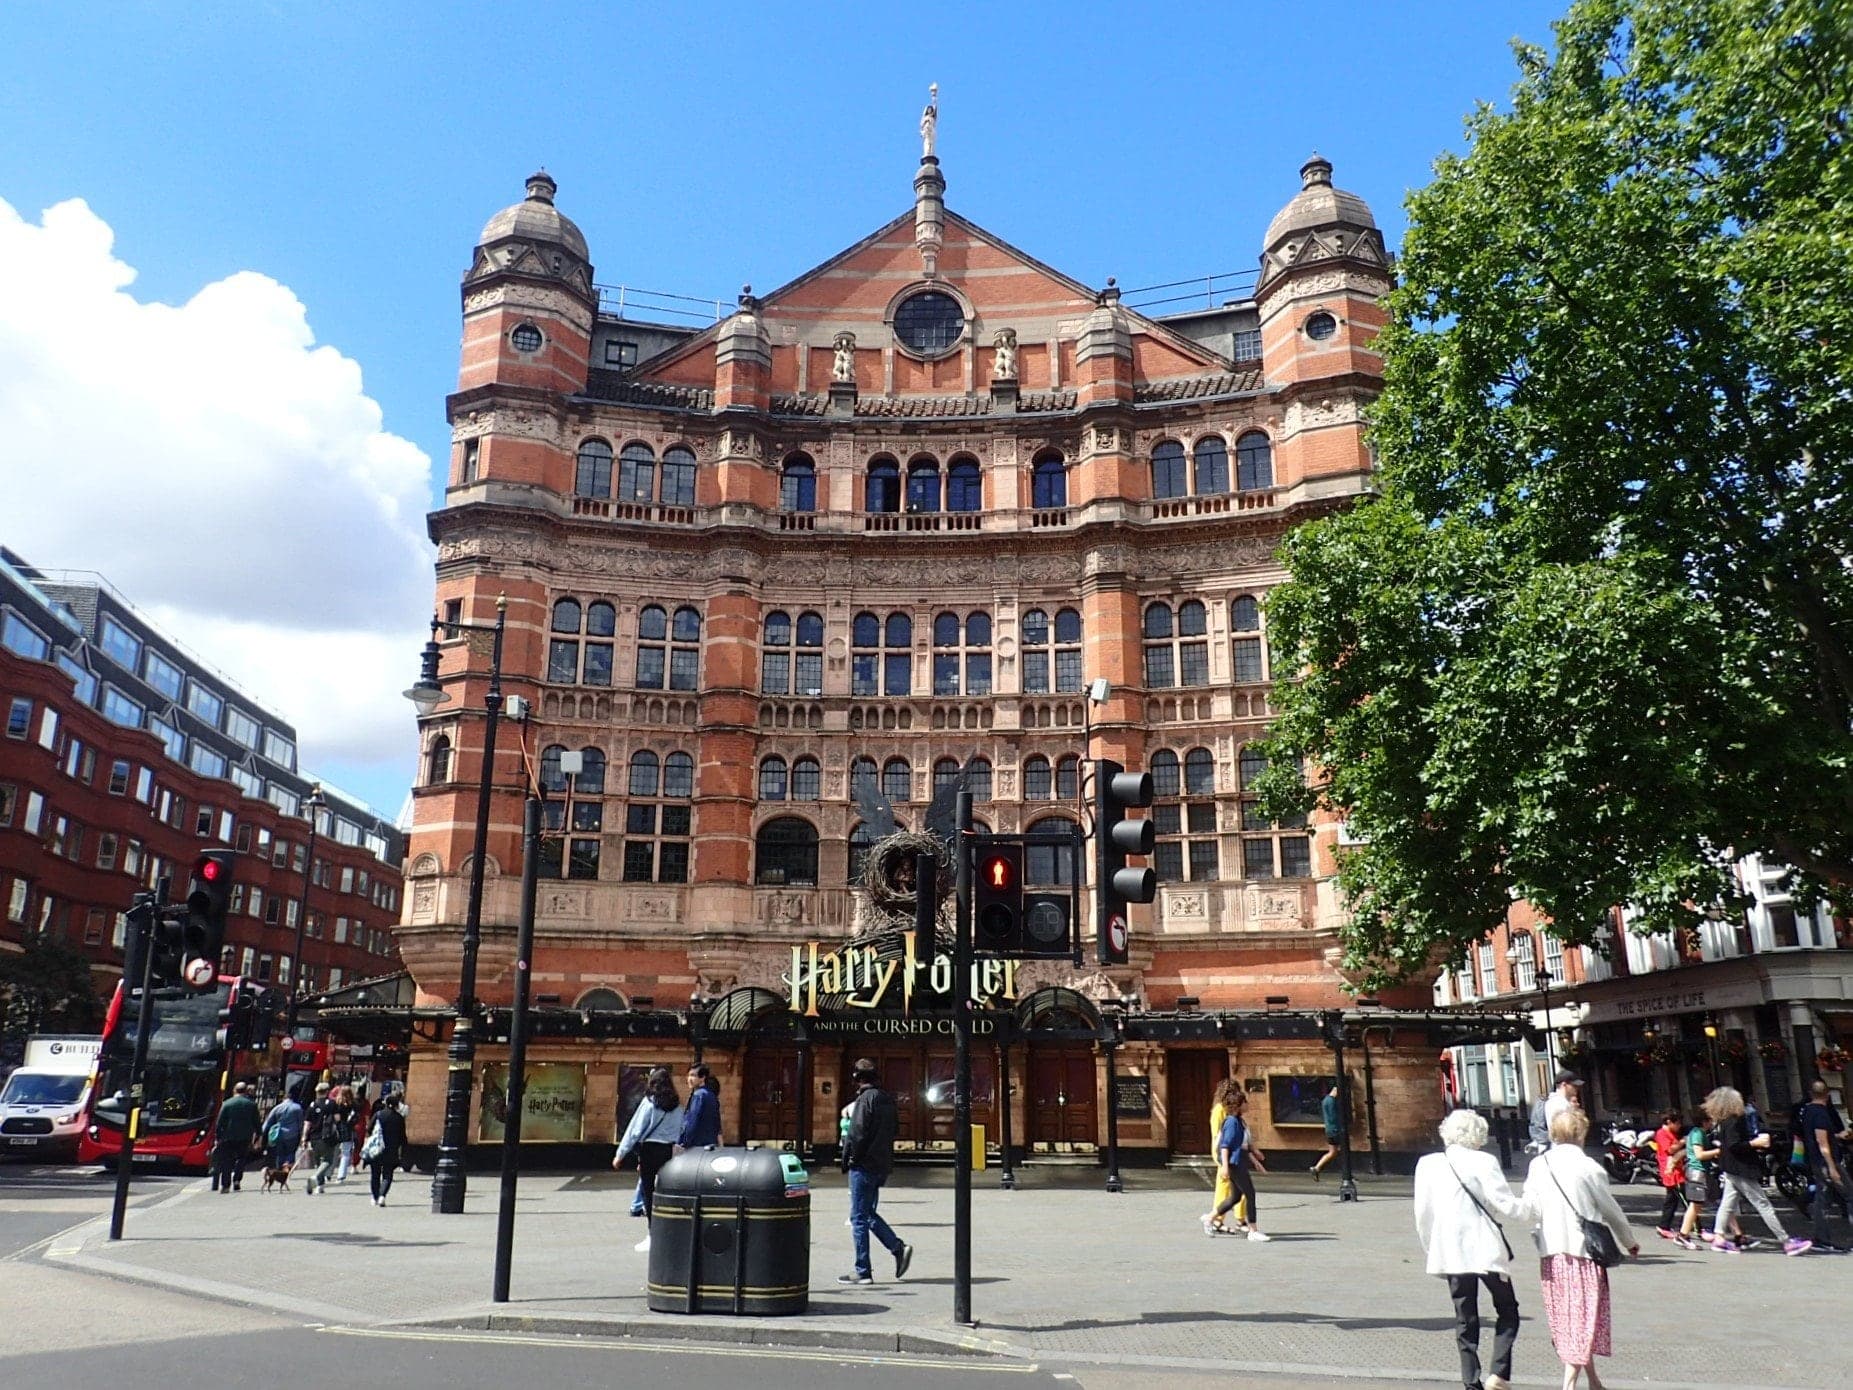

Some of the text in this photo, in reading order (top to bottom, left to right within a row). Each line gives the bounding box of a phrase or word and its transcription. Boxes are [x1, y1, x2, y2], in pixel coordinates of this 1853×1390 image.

[781, 931, 1021, 1018] Harry Poter
[1617, 992, 1706, 1015] THE SPICE OF LIFE
[814, 1019, 994, 1034] AND THE CURSED CLD
[191, 1035, 208, 1049] 14
